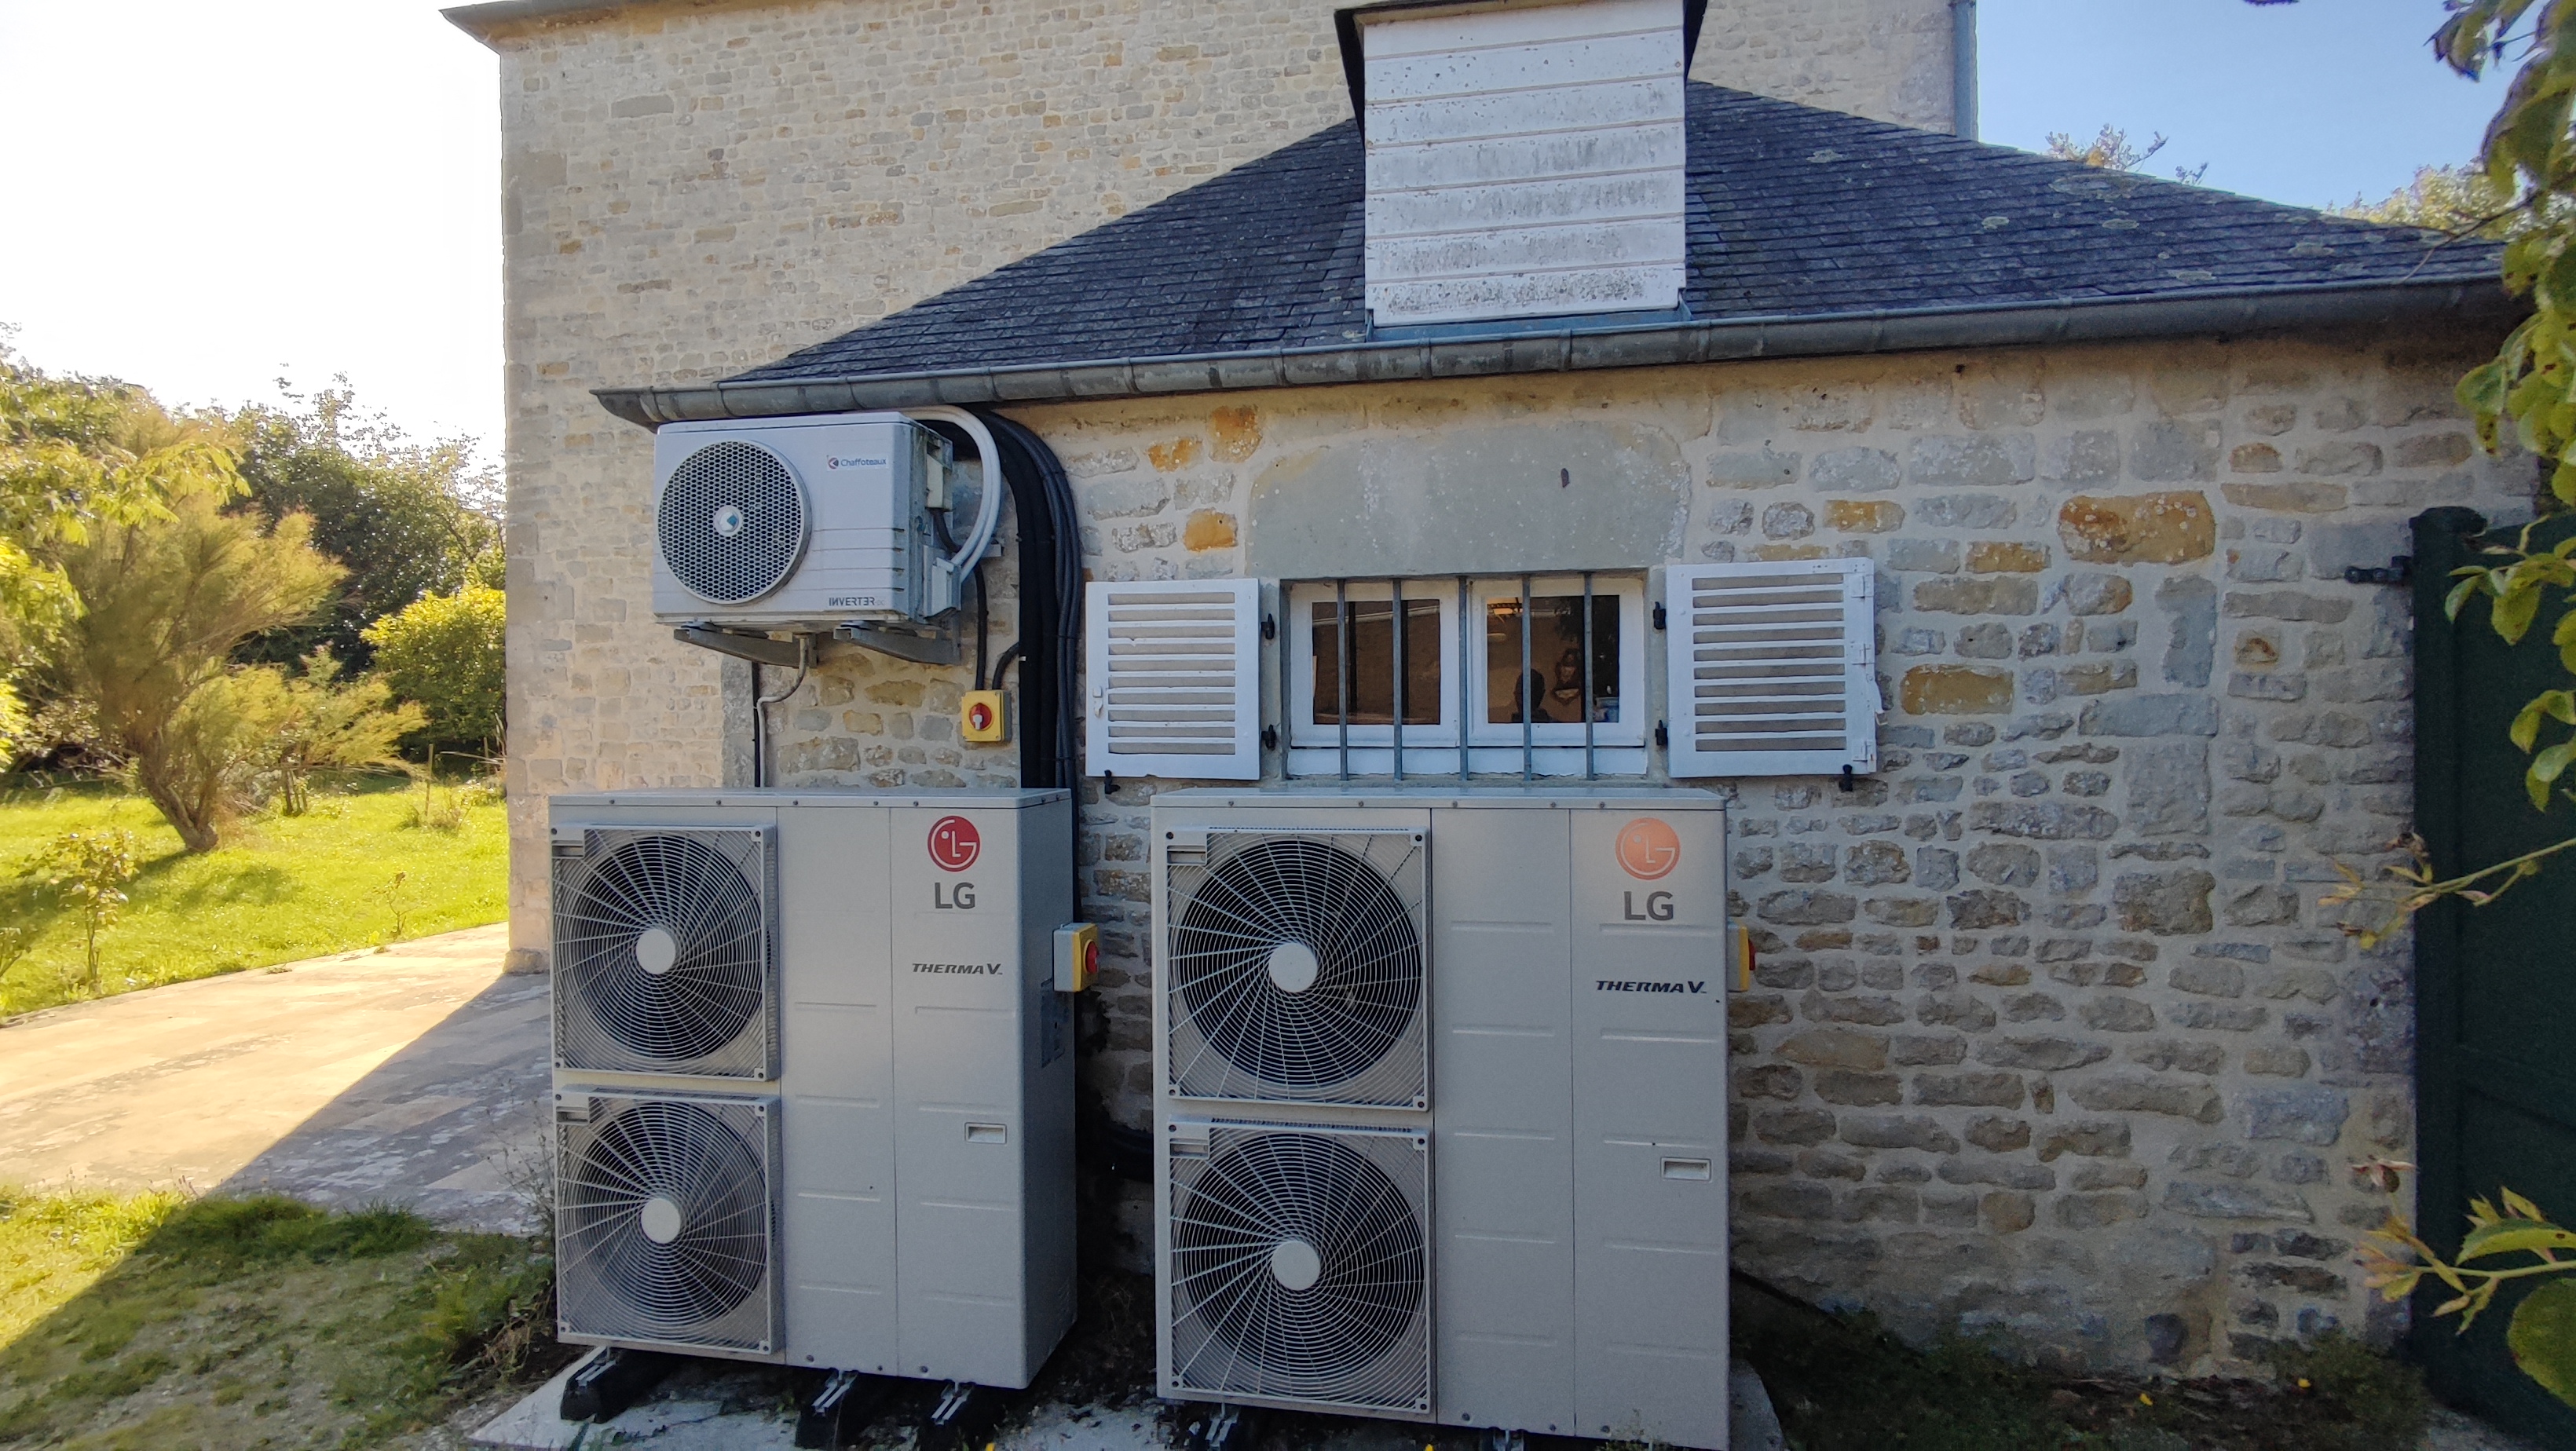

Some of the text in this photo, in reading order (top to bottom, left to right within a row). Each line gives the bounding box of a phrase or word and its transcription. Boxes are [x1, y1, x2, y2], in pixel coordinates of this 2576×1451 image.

[840, 458, 887, 466] Chaffoteaux
[934, 882, 975, 909] LG
[1623, 890, 1674, 921] LG
[912, 963, 984, 974] THERMA
[1596, 980, 1684, 993] THERMA
